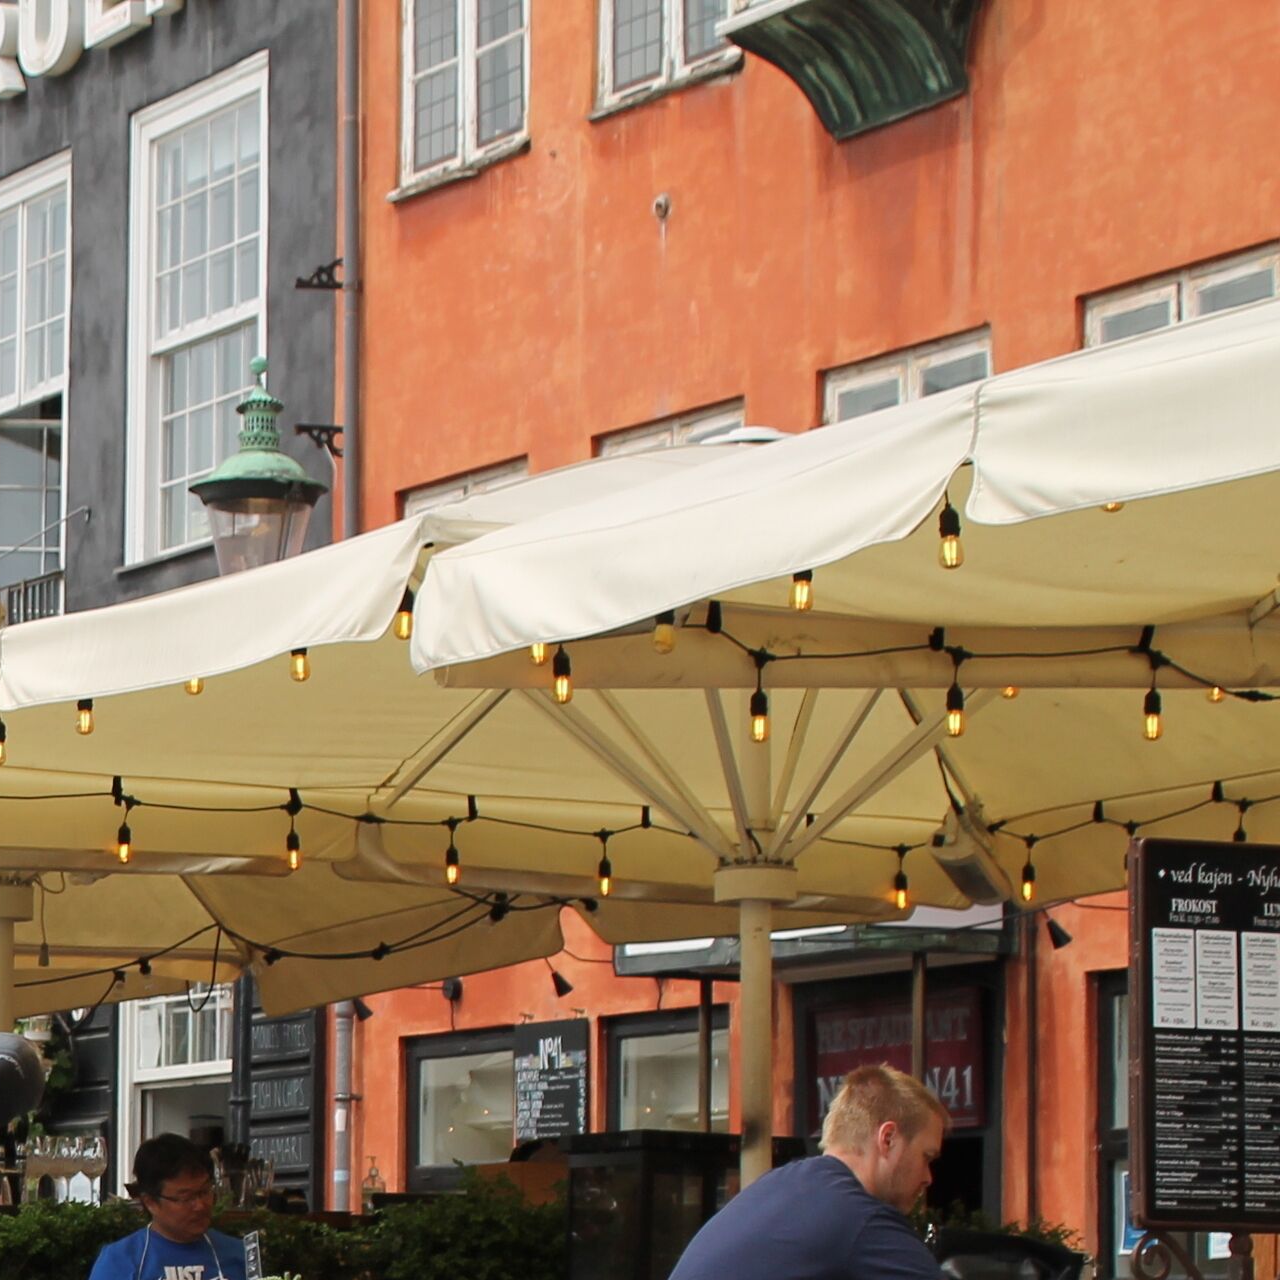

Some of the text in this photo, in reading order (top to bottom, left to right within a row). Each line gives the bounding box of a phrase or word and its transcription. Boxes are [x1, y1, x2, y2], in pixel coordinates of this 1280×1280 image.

[1169, 862, 1197, 883] ved
[1197, 862, 1233, 893] kajen
[1171, 898, 1218, 914] FROKOST
